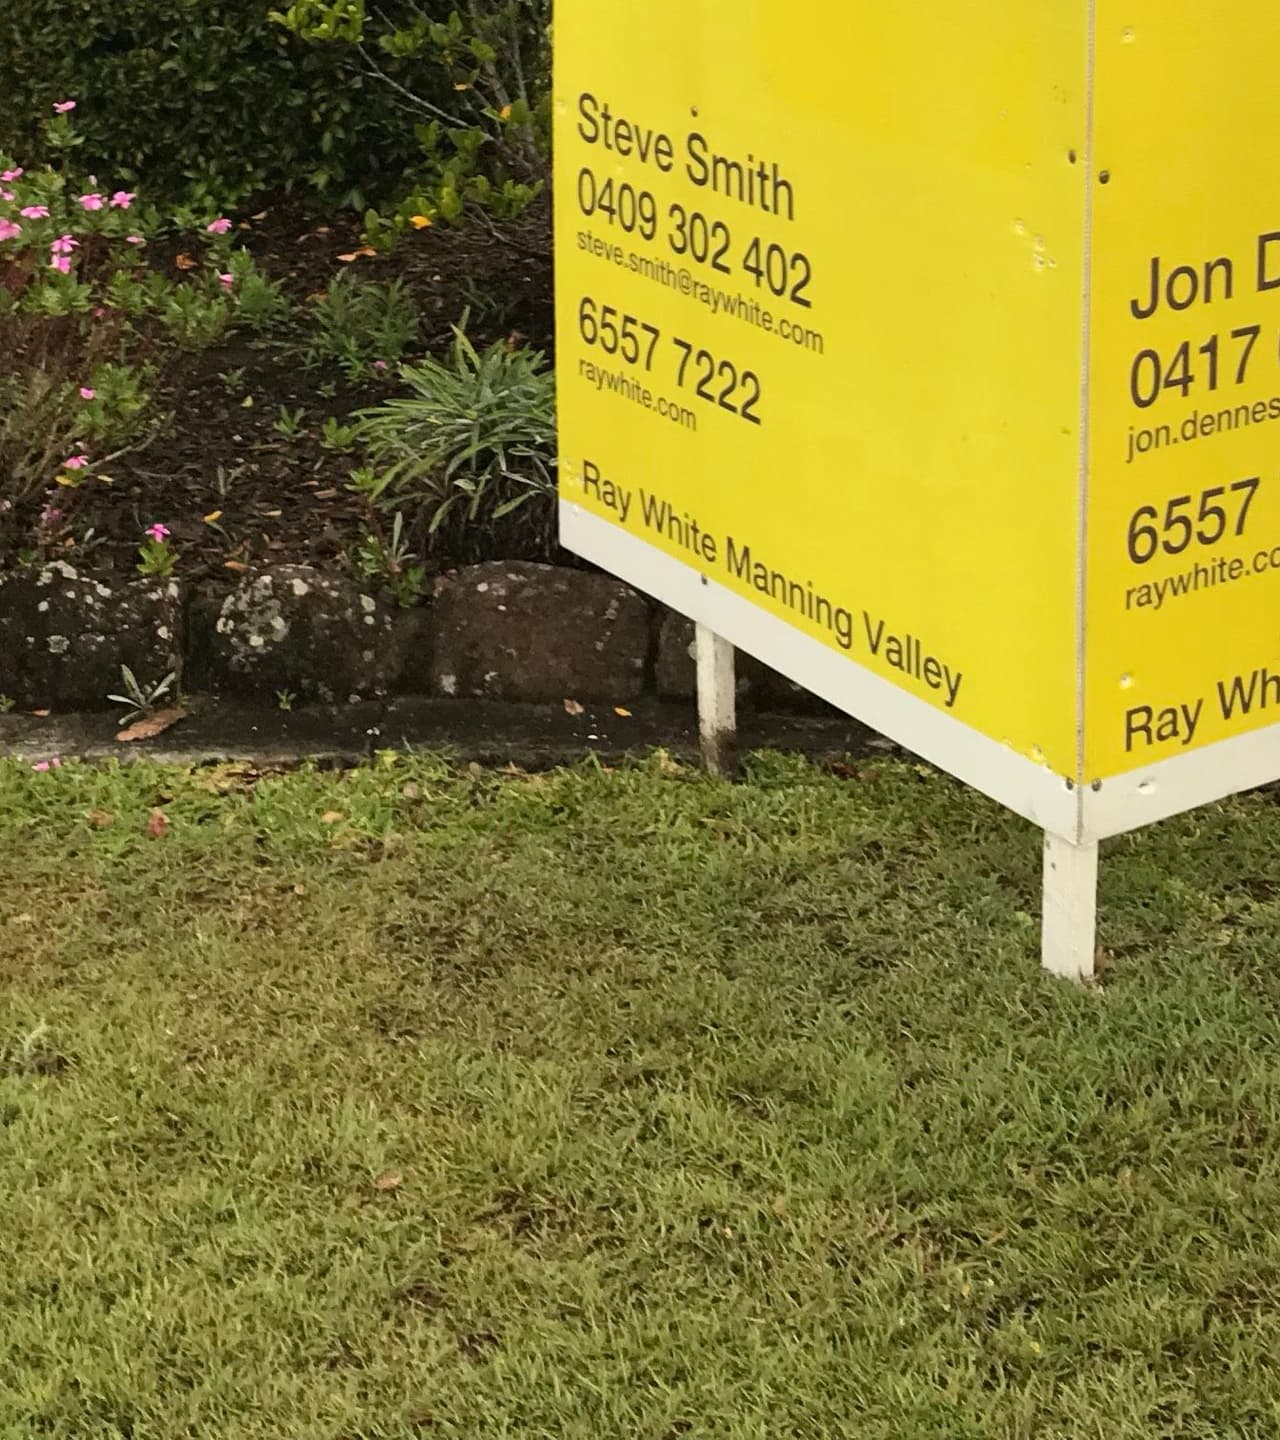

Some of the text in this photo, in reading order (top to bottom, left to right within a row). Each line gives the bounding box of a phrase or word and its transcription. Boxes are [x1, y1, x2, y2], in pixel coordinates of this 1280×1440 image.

[577, 92, 793, 221] Steve Smith
[577, 167, 813, 308] 0409 302 402
[1131, 256, 1232, 319] Jon
[577, 229, 823, 355] steve.smith@raywhite.com
[578, 296, 761, 425] 6557 7222
[578, 357, 697, 432] raywhite.com
[1130, 326, 1261, 409] 0417
[1127, 479, 1260, 565] 6557
[583, 460, 962, 706] Ray White Manning Valley
[1125, 698, 1203, 752] Ray
